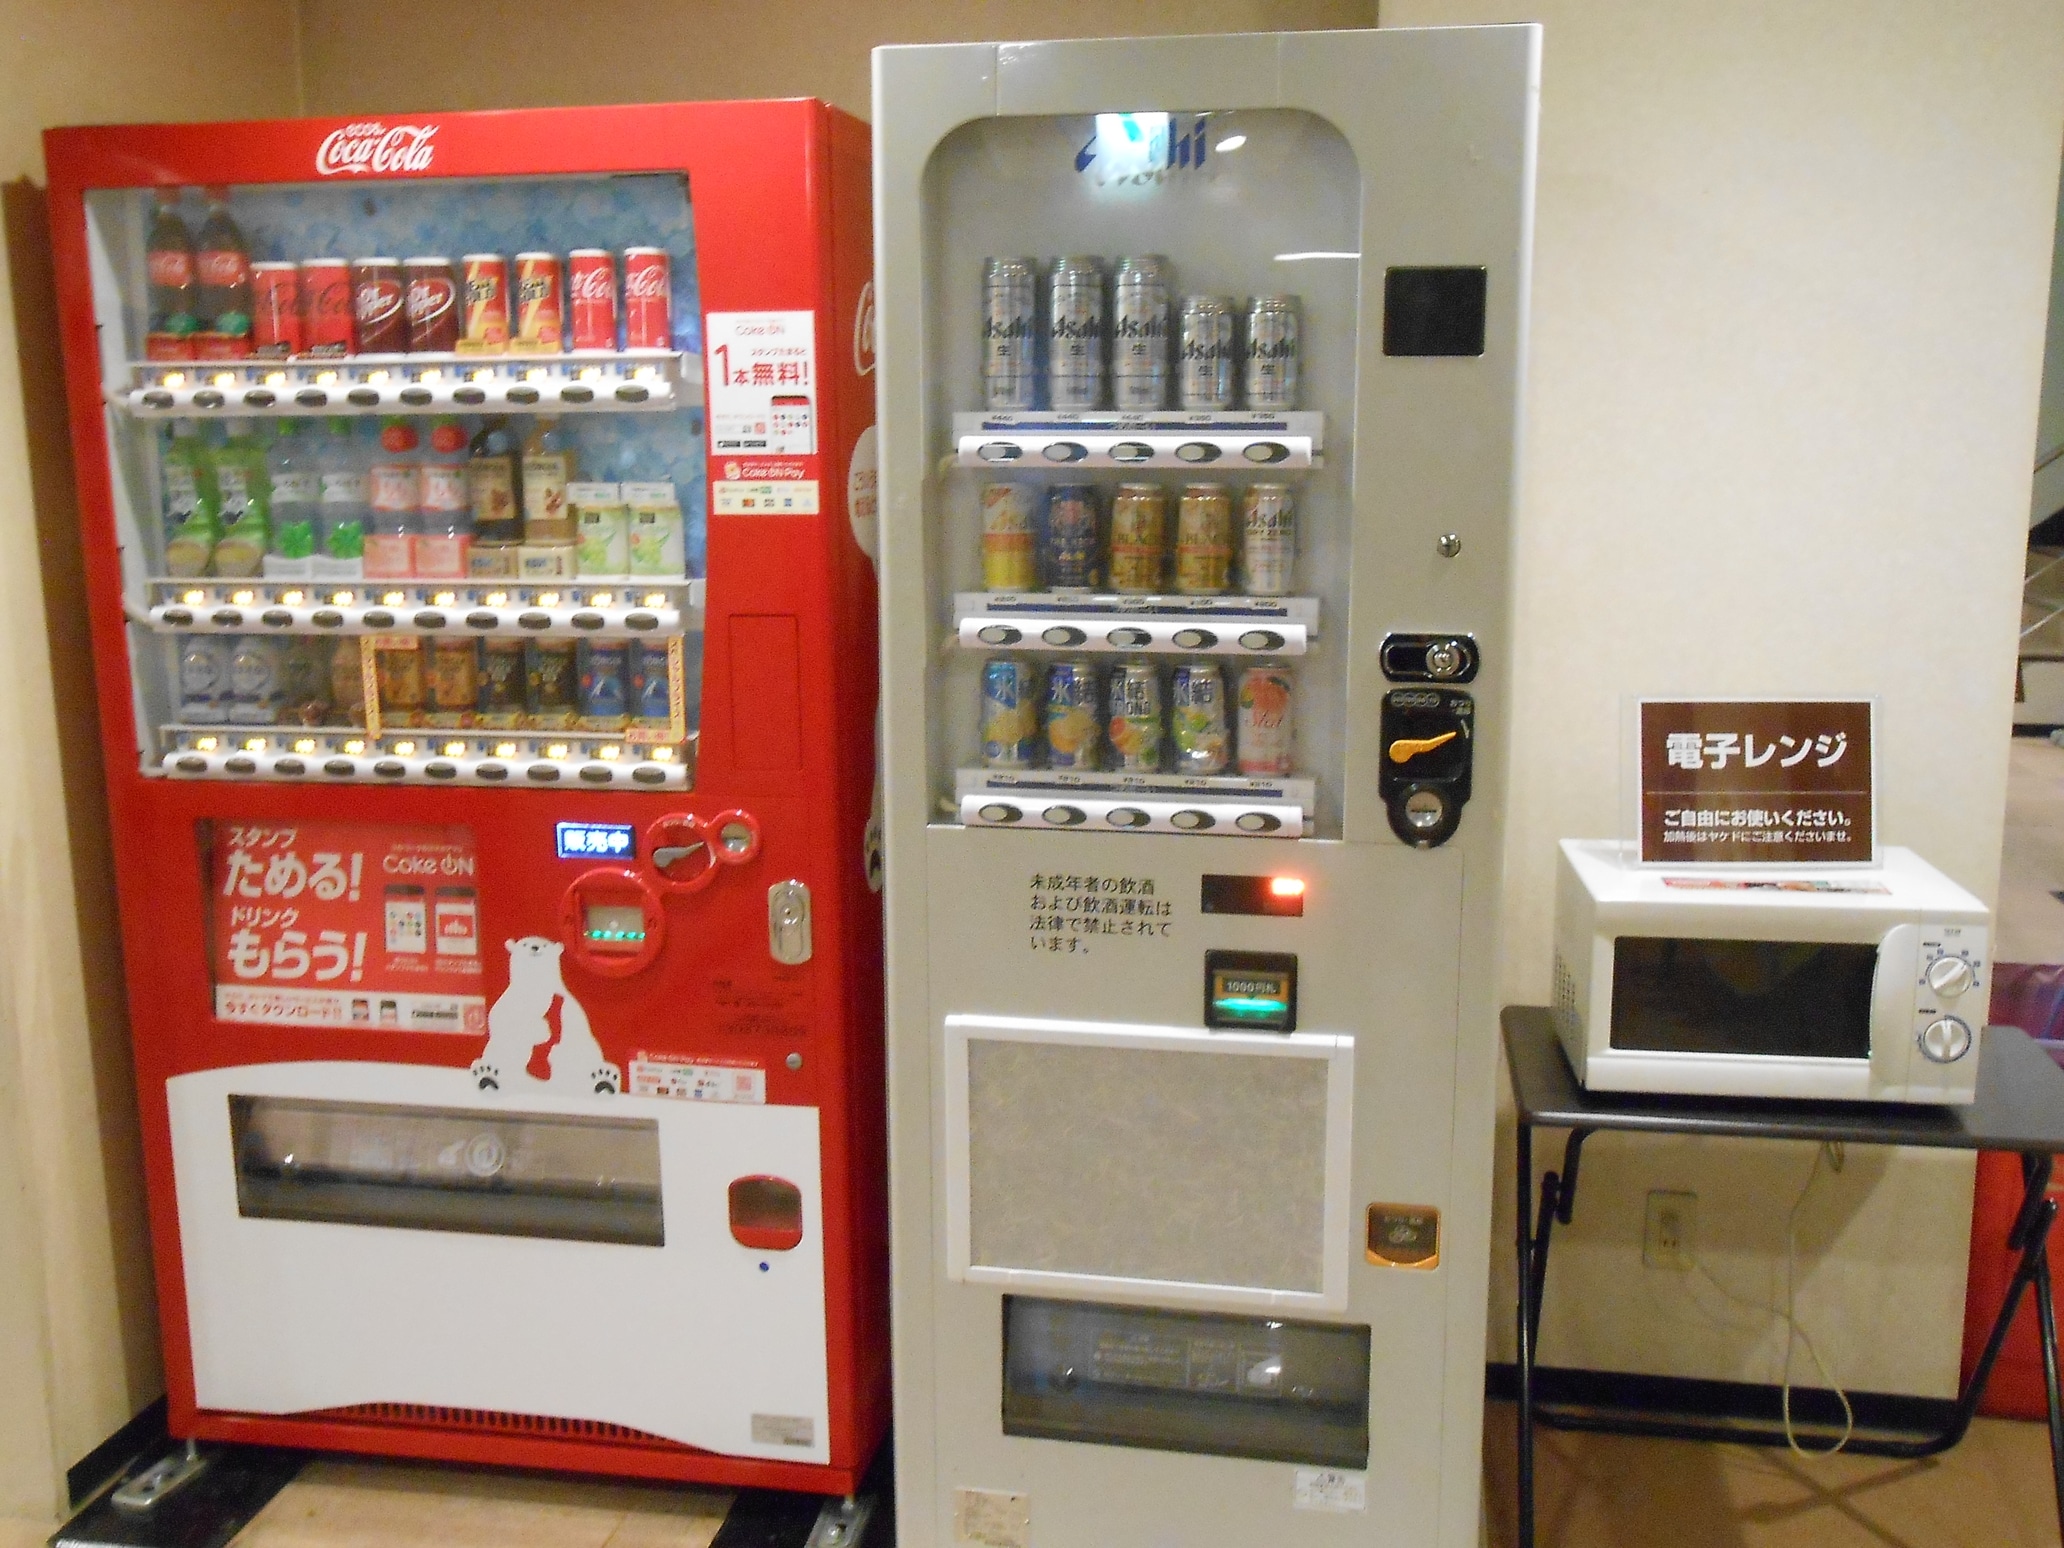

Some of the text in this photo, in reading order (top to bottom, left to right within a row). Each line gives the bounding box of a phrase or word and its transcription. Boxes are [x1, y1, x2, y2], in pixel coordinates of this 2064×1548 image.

[315, 124, 440, 175] Coca-Cola
[1666, 731, 1848, 770] 電子レンジ
[1664, 809, 1851, 828] ご自由にお使いください。
[223, 849, 364, 902] ためる!
[382, 854, 437, 875] Coke
[1030, 873, 1155, 896] 未成年者の飲酒
[1030, 893, 1173, 916] および飲酒運転は
[230, 905, 300, 929] ドリンク
[1029, 914, 1173, 937] 法律で禁止されて
[227, 927, 368, 982] もらう!
[1030, 935, 1089, 954] います。
